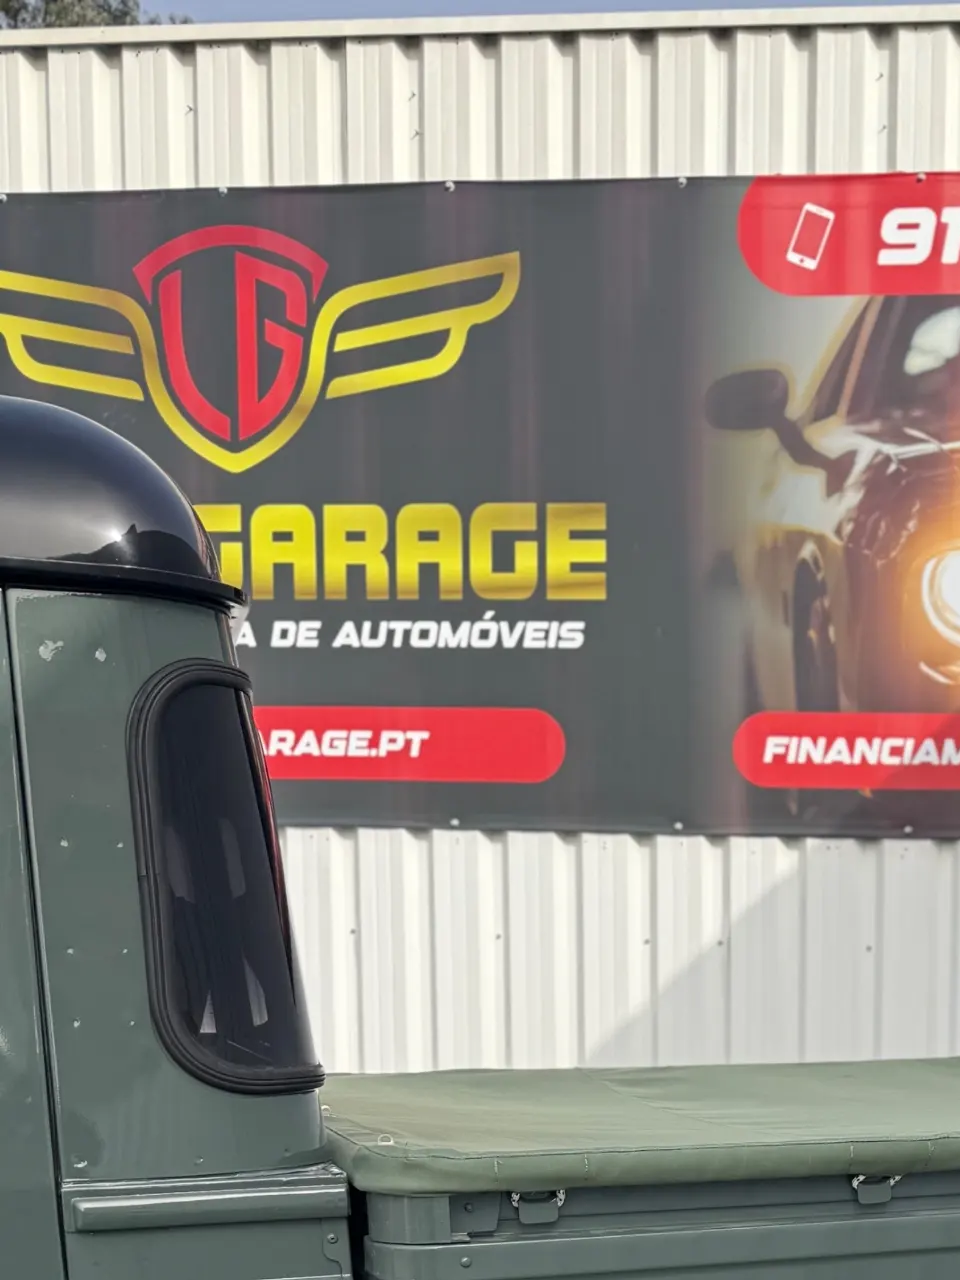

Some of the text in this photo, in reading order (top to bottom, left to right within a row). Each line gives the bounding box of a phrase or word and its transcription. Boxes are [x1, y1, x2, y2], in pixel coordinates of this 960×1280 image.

[270, 620, 322, 648] DE
[332, 611, 586, 649] AUTOMÓVEIS
[258, 729, 430, 758] RAGE.PT
